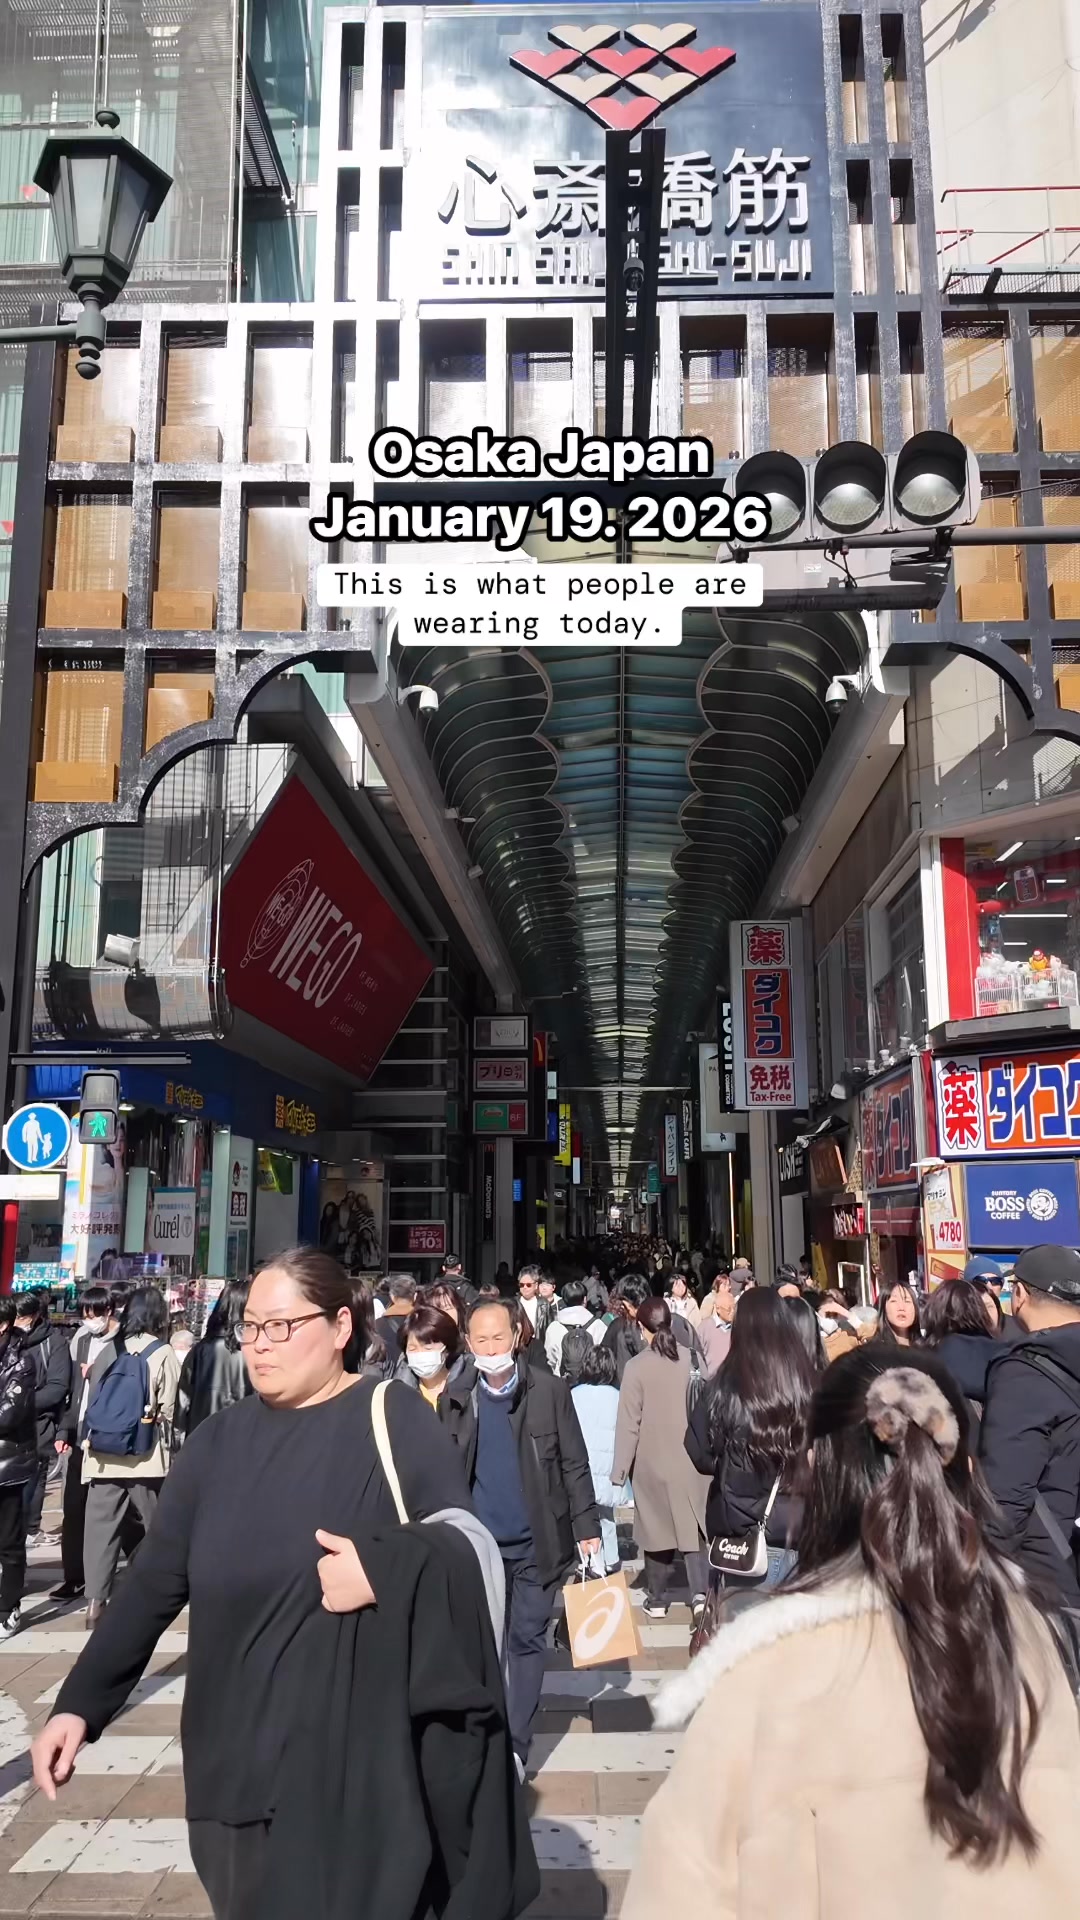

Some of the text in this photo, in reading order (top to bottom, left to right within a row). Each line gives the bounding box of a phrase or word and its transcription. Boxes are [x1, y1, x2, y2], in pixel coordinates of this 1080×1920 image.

[268, 886, 363, 1008] WEGO
[745, 925, 785, 966] 薬
[753, 972, 783, 1056] ダイコク
[749, 1065, 791, 1090] 免税
[750, 1091, 792, 1102] Tax-Free
[939, 1061, 982, 1149] 薬
[984, 1196, 1025, 1212] BOSS
[990, 1212, 1021, 1220] COFFEE
[153, 1213, 180, 1239] Curél
[939, 1221, 962, 1242] 4780
[718, 1538, 749, 1556] Coach
